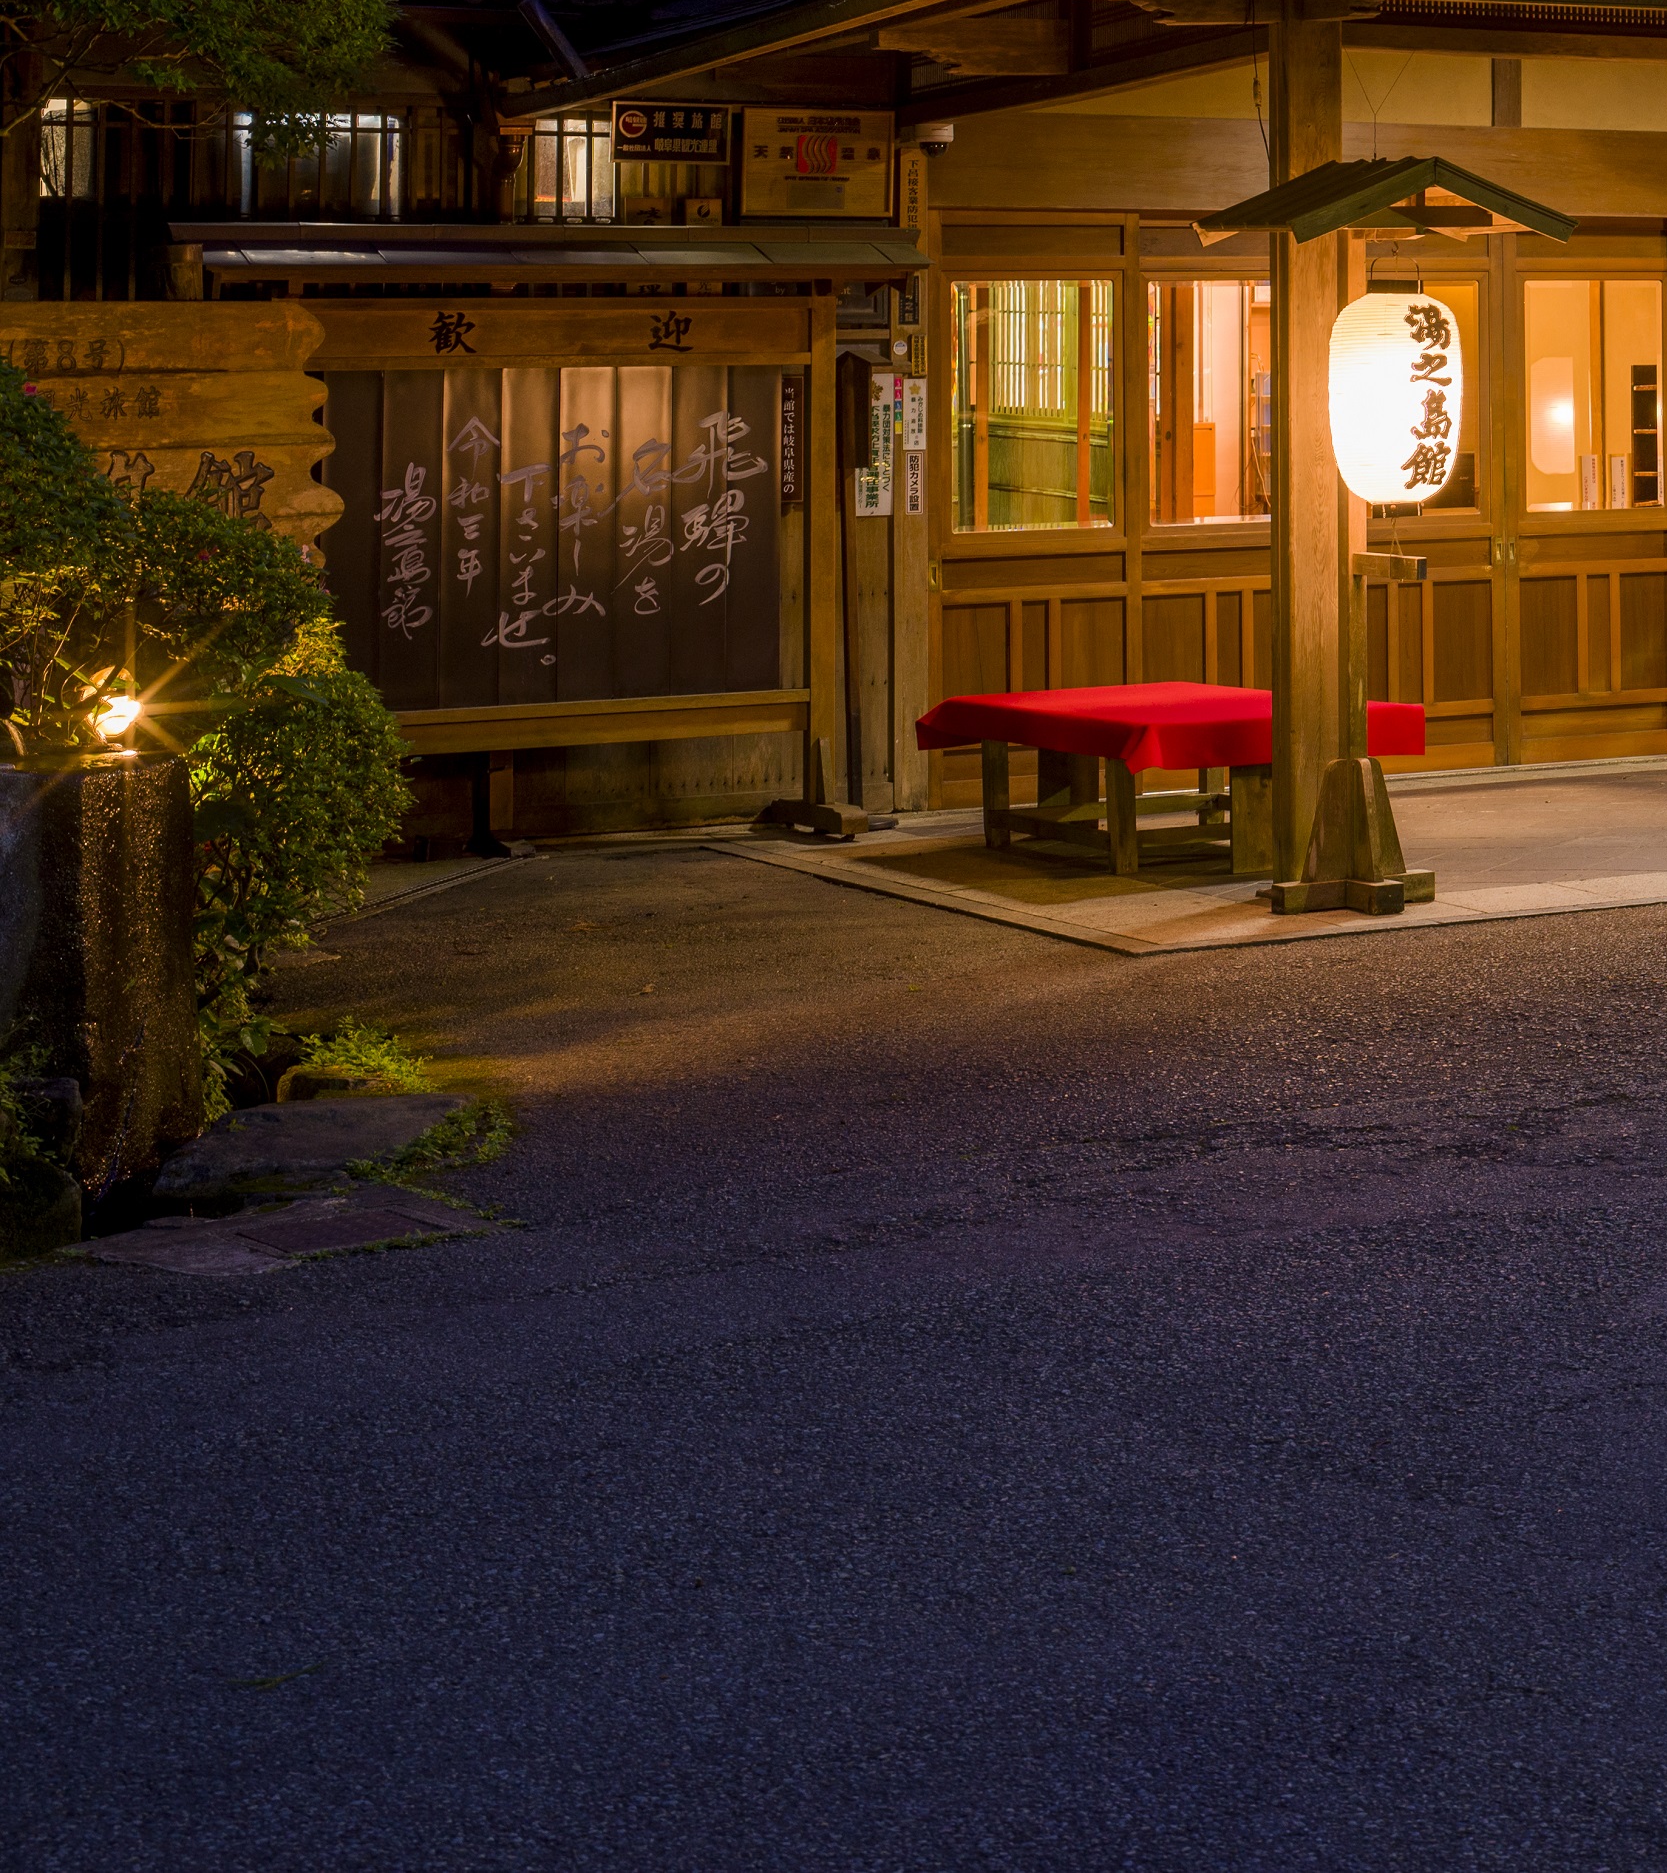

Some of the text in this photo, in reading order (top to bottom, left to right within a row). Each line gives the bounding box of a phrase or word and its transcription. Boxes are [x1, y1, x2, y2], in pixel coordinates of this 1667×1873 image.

[653, 111, 722, 129] 推奨旅館
[654, 137, 718, 154] 岐阜県観光連盟
[428, 310, 694, 354] 歓迎
[1400, 303, 1453, 489] 湯之島館
[783, 387, 796, 494] 当館では岐阜県産の
[447, 416, 501, 598] 令和三年
[909, 455, 920, 512] 防犯カメラ設置
